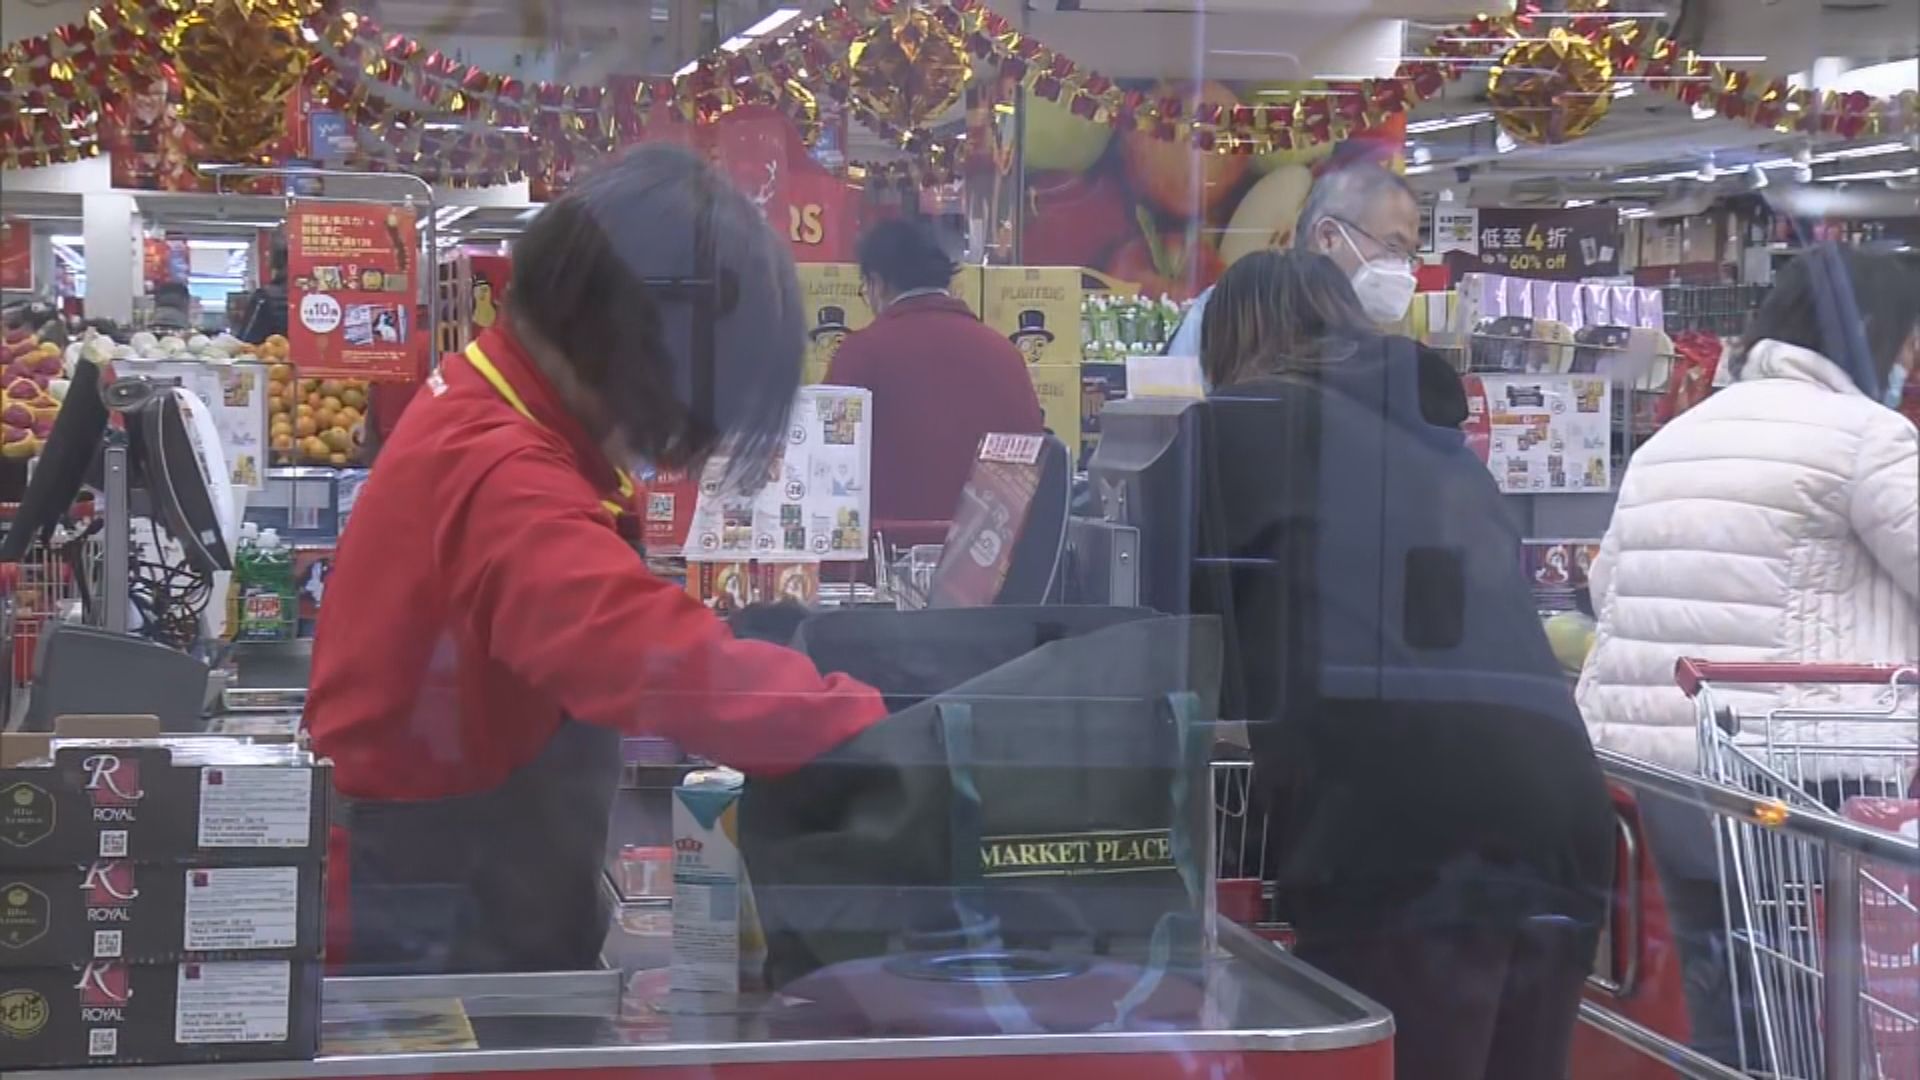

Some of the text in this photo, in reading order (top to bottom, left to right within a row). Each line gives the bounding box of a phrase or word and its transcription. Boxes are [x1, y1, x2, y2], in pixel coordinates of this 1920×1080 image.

[1509, 253, 1542, 270] 60%
[1545, 253, 1568, 270] off
[93, 808, 136, 822] ROYAL
[980, 837, 1173, 868] MARKET PLACE
[87, 907, 131, 922] ROYAL
[81, 1007, 125, 1021] ROYAL
